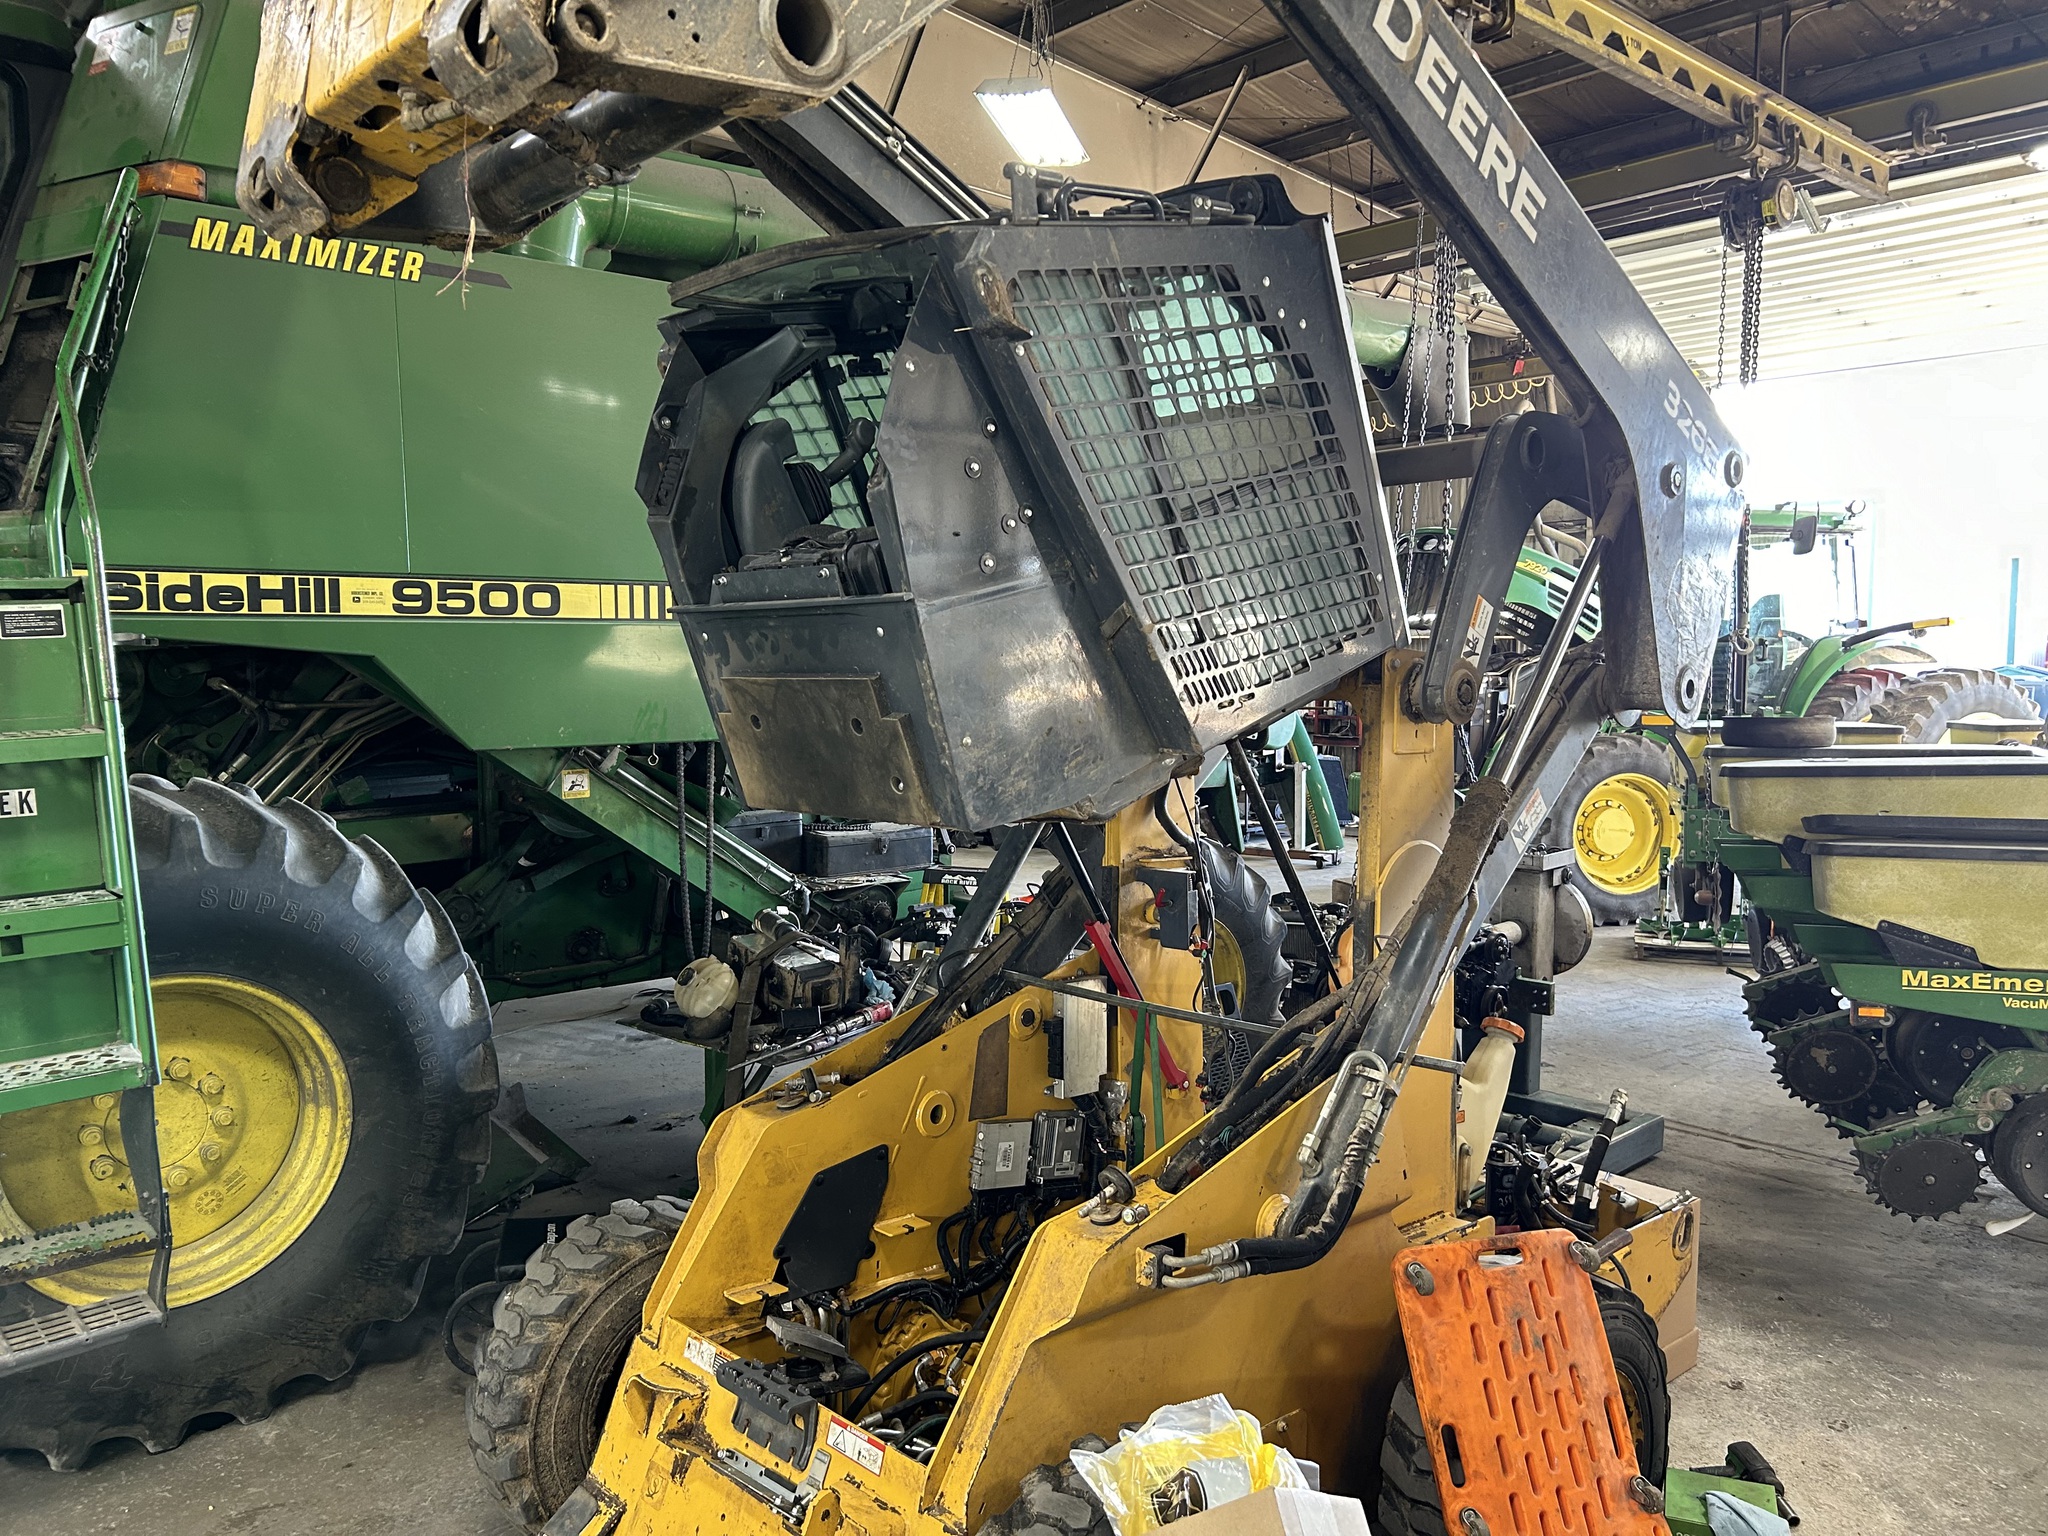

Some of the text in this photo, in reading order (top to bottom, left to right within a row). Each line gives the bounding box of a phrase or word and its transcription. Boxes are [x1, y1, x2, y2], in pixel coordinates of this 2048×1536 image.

[1630, 37, 1641, 51] TON
[1372, 0, 1547, 244] DEERE
[190, 217, 425, 282] MAXIMIZER
[1524, 558, 1548, 574] 7920
[105, 572, 341, 613] SideHill
[392, 580, 561, 616] 9500
[1902, 970, 2048, 993] MaxEme
[200, 886, 326, 933] SUPER
[340, 931, 393, 984] ALL
[397, 991, 442, 1147] TRACTION
[547, 1223, 558, 1245] nap-on
